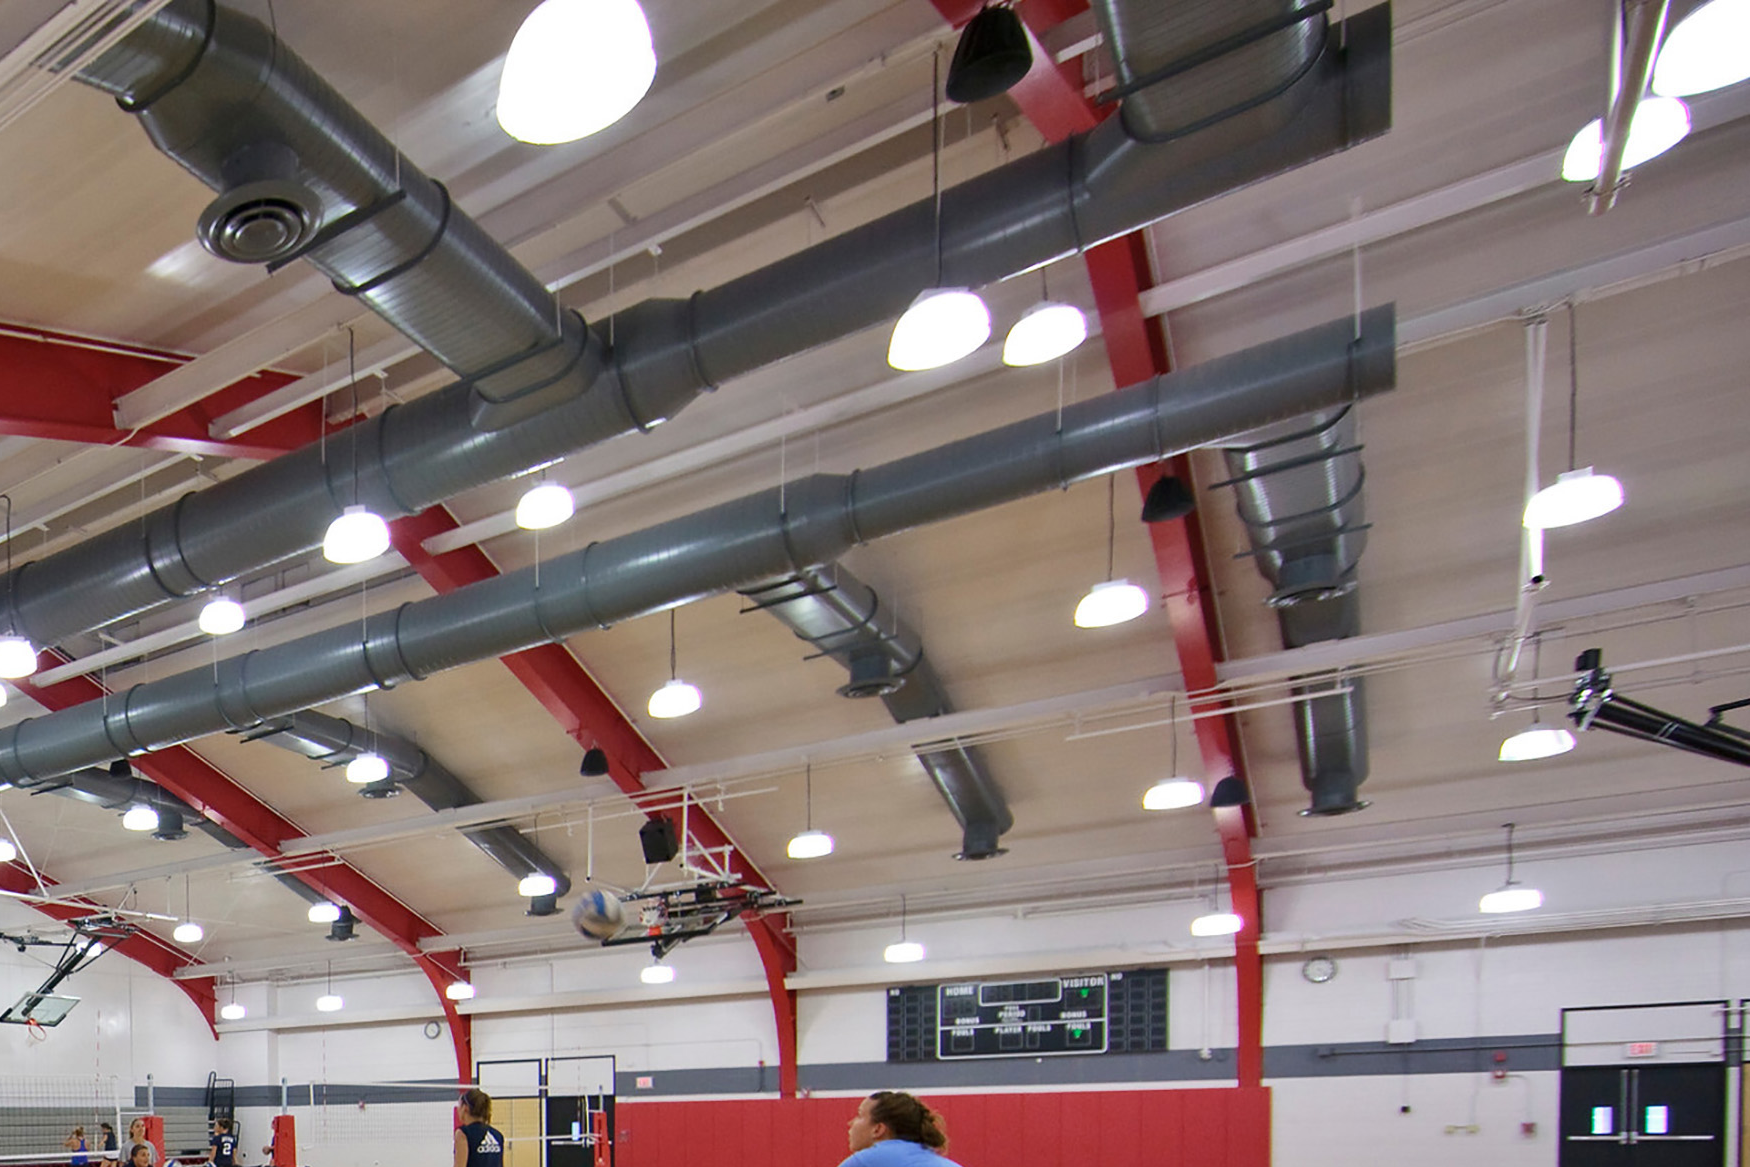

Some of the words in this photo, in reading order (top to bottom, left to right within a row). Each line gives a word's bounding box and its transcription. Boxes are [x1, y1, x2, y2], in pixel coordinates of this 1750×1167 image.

[1063, 977, 1104, 988] VISITOR
[946, 986, 974, 996] HOME
[998, 1010, 1026, 1018] PERIOD
[1060, 1011, 1088, 1019] BONUS
[955, 1016, 980, 1025] BONUS
[951, 1028, 975, 1036] FOULS
[995, 1025, 1023, 1034] PLAYER
[1027, 1024, 1052, 1032] FOULS
[222, 1143, 231, 1155] 2
[477, 1144, 501, 1153] adidas
